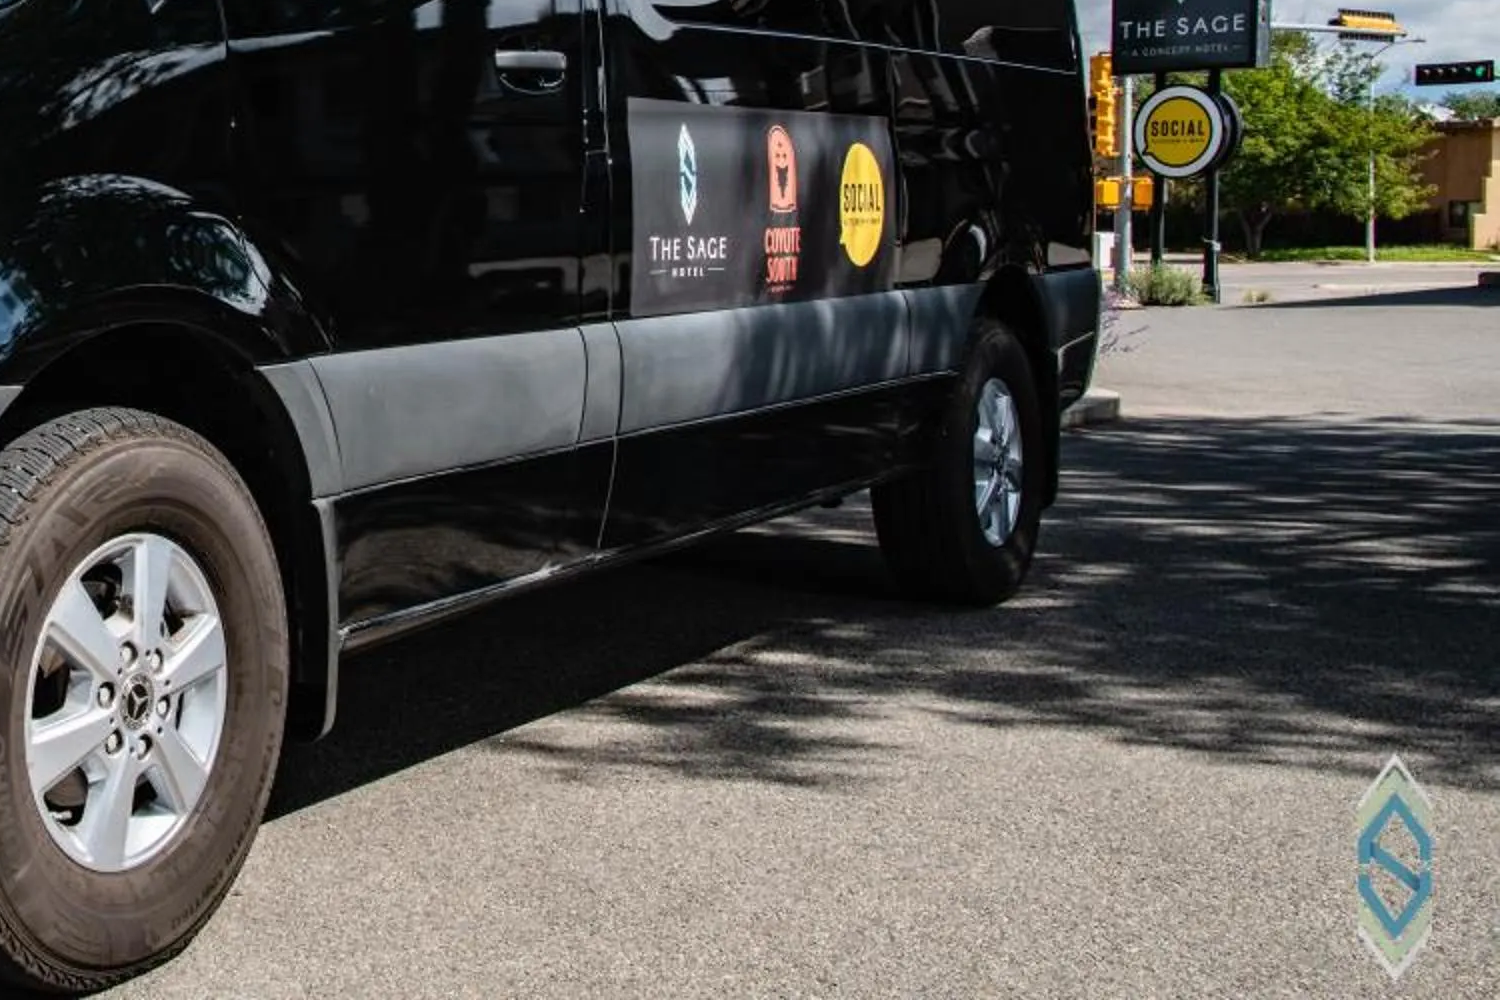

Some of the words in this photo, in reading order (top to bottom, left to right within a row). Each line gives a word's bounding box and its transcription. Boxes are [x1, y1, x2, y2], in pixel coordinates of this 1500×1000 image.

[1120, 20, 1166, 39] THE
[1176, 13, 1245, 35] SAGE
[1151, 120, 1205, 137] SOCIAL
[844, 183, 881, 213] SOCIAL
[649, 236, 681, 261] THE
[687, 235, 728, 260] SAGE
[764, 227, 801, 254] COYOTE
[671, 267, 704, 278] HOTEL
[765, 256, 798, 283] SOUTH
